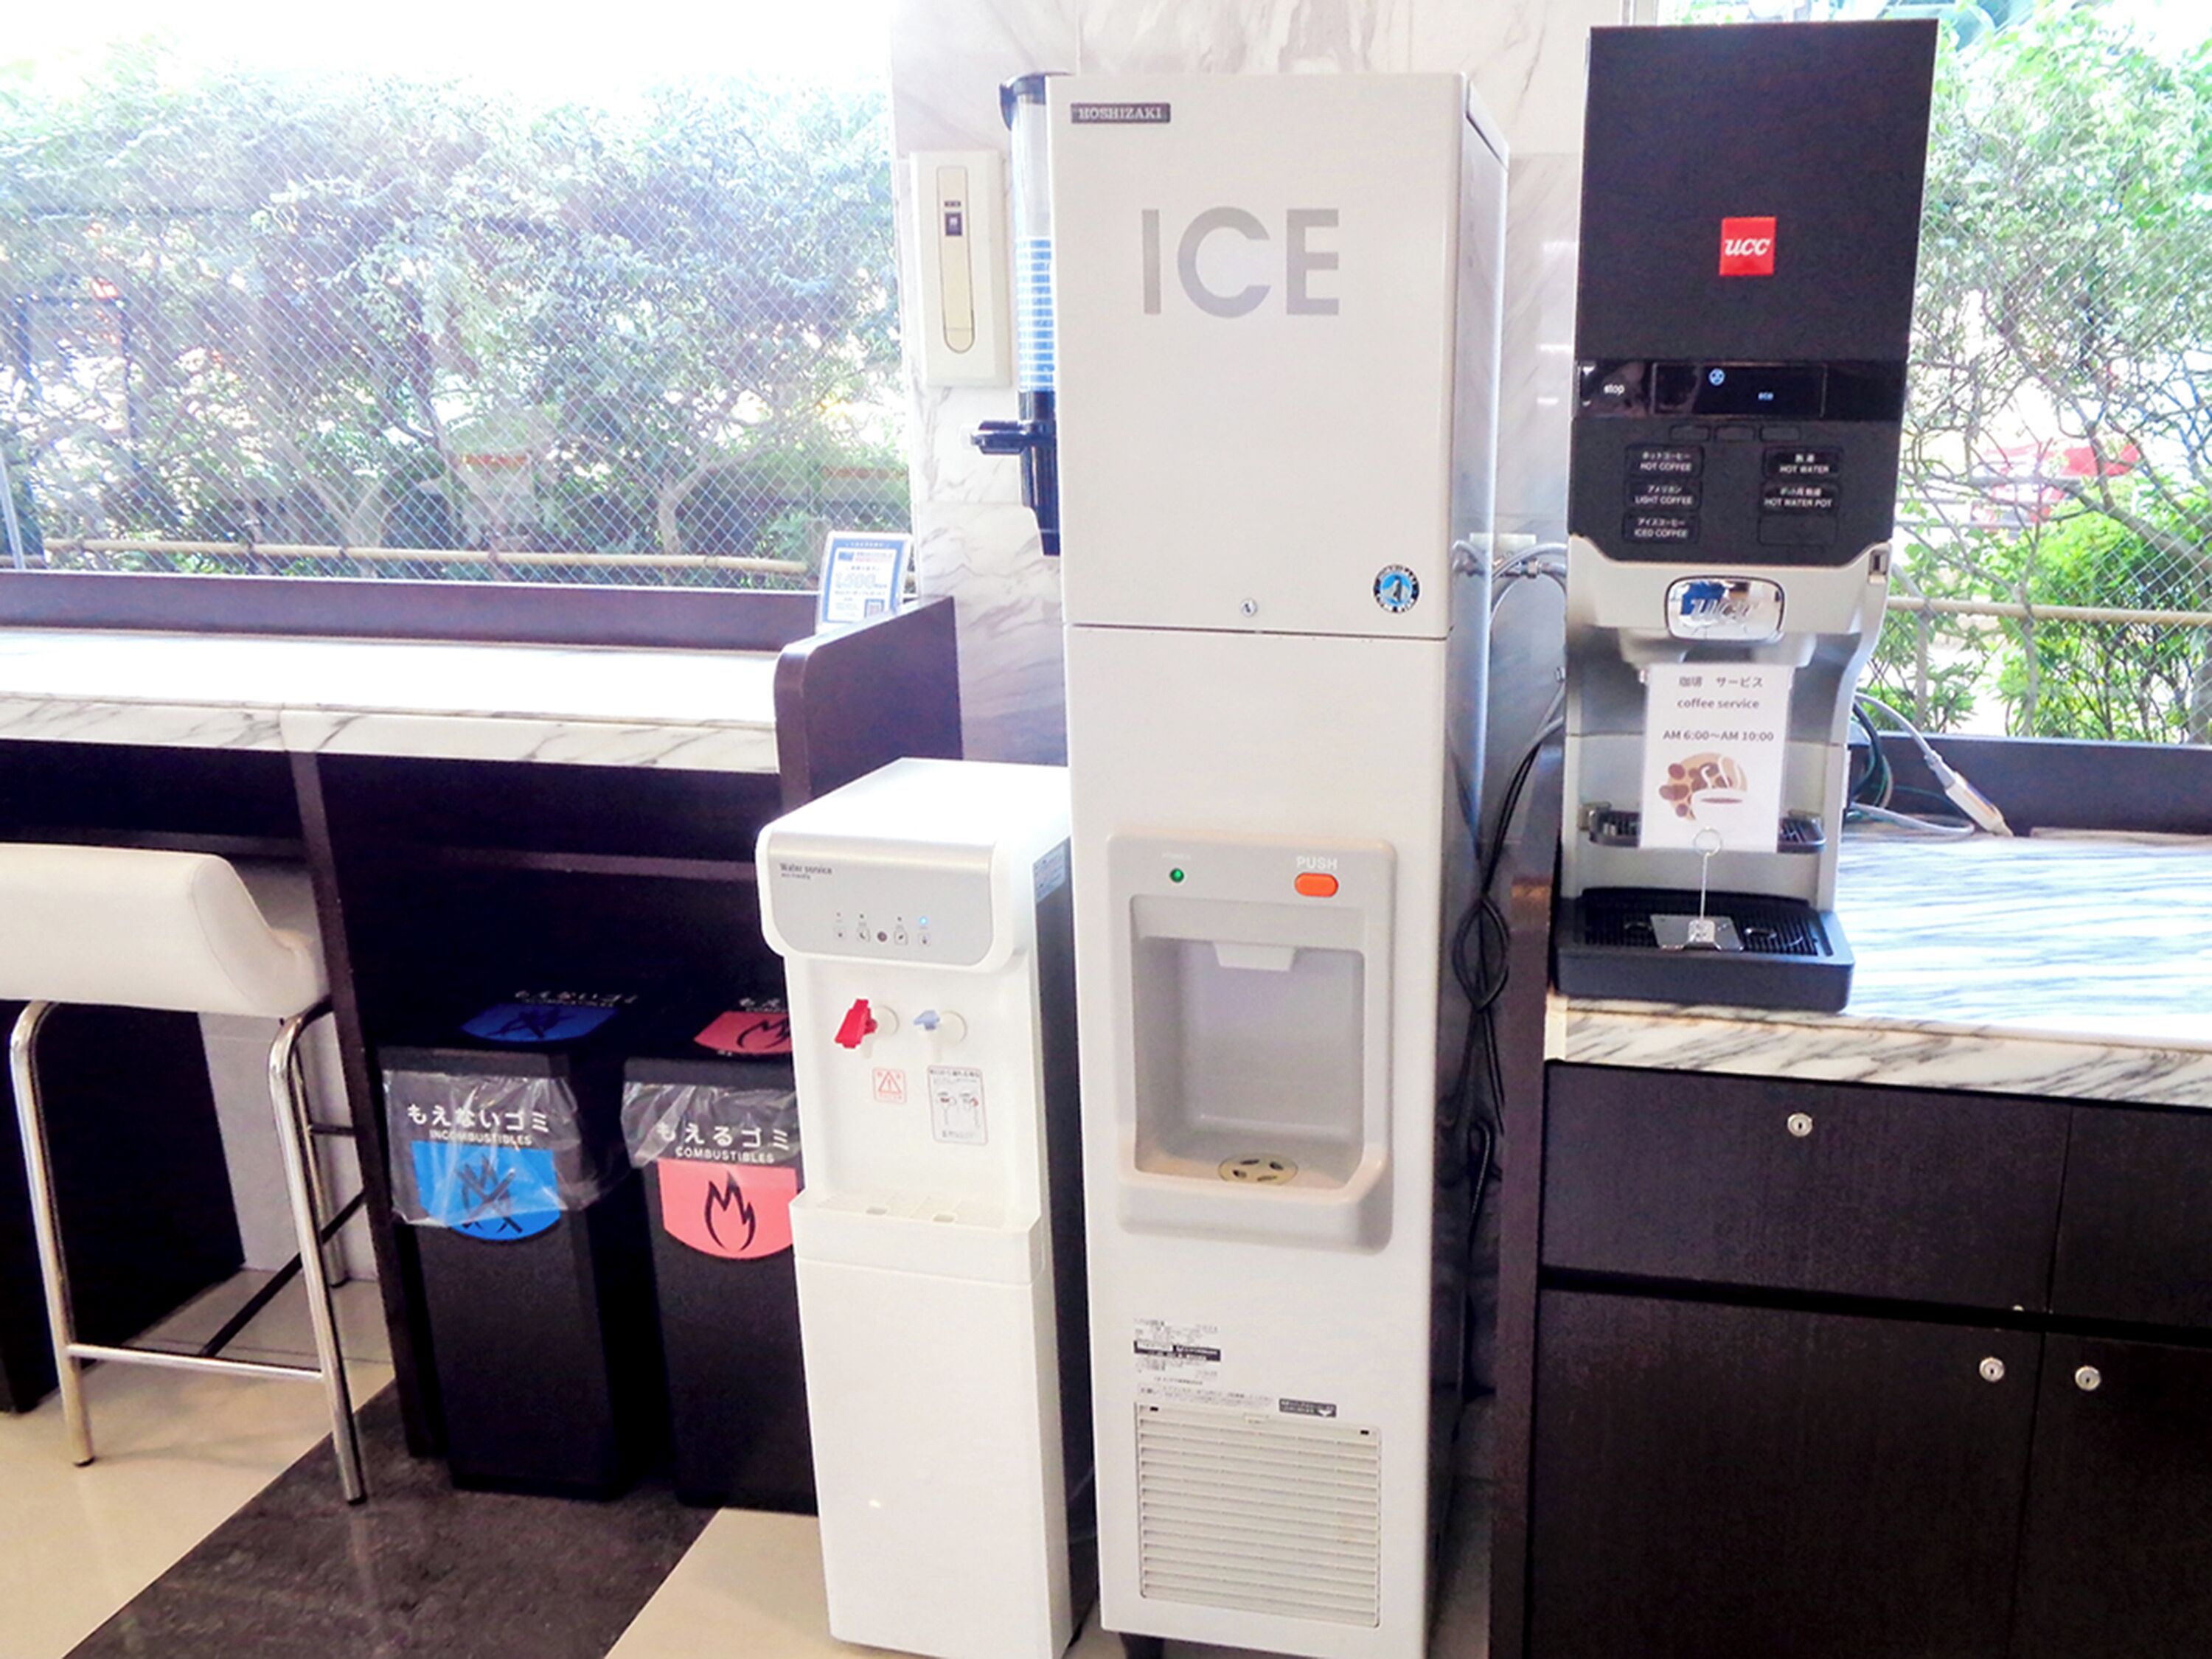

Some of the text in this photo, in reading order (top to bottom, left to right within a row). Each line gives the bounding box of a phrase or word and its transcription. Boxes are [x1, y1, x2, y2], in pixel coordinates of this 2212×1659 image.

[1079, 107, 1162, 119] HOSHIZAKI
[1141, 206, 1339, 319] ICE
[1604, 383, 1625, 397] stop
[1640, 462, 1692, 472] HOT COFFEE
[1779, 465, 1829, 474] HOT WATER
[1635, 495, 1693, 505] LIGHT COFFEE
[1764, 498, 1833, 507] HOT WATER POT
[1634, 528, 1688, 538] ICED COFFEE
[1717, 676, 1763, 688] サービス
[1677, 697, 1759, 709] coffee service
[1663, 730, 1681, 740] AM
[1742, 731, 1775, 742] 10:00
[1296, 855, 1338, 871] PUSH
[407, 1103, 549, 1133] もえないゴミ
[429, 1128, 532, 1147] INCOMBUSTIBLES
[655, 1121, 790, 1152] もえるゴミ
[675, 1147, 775, 1165] COMBUSTIBLES
